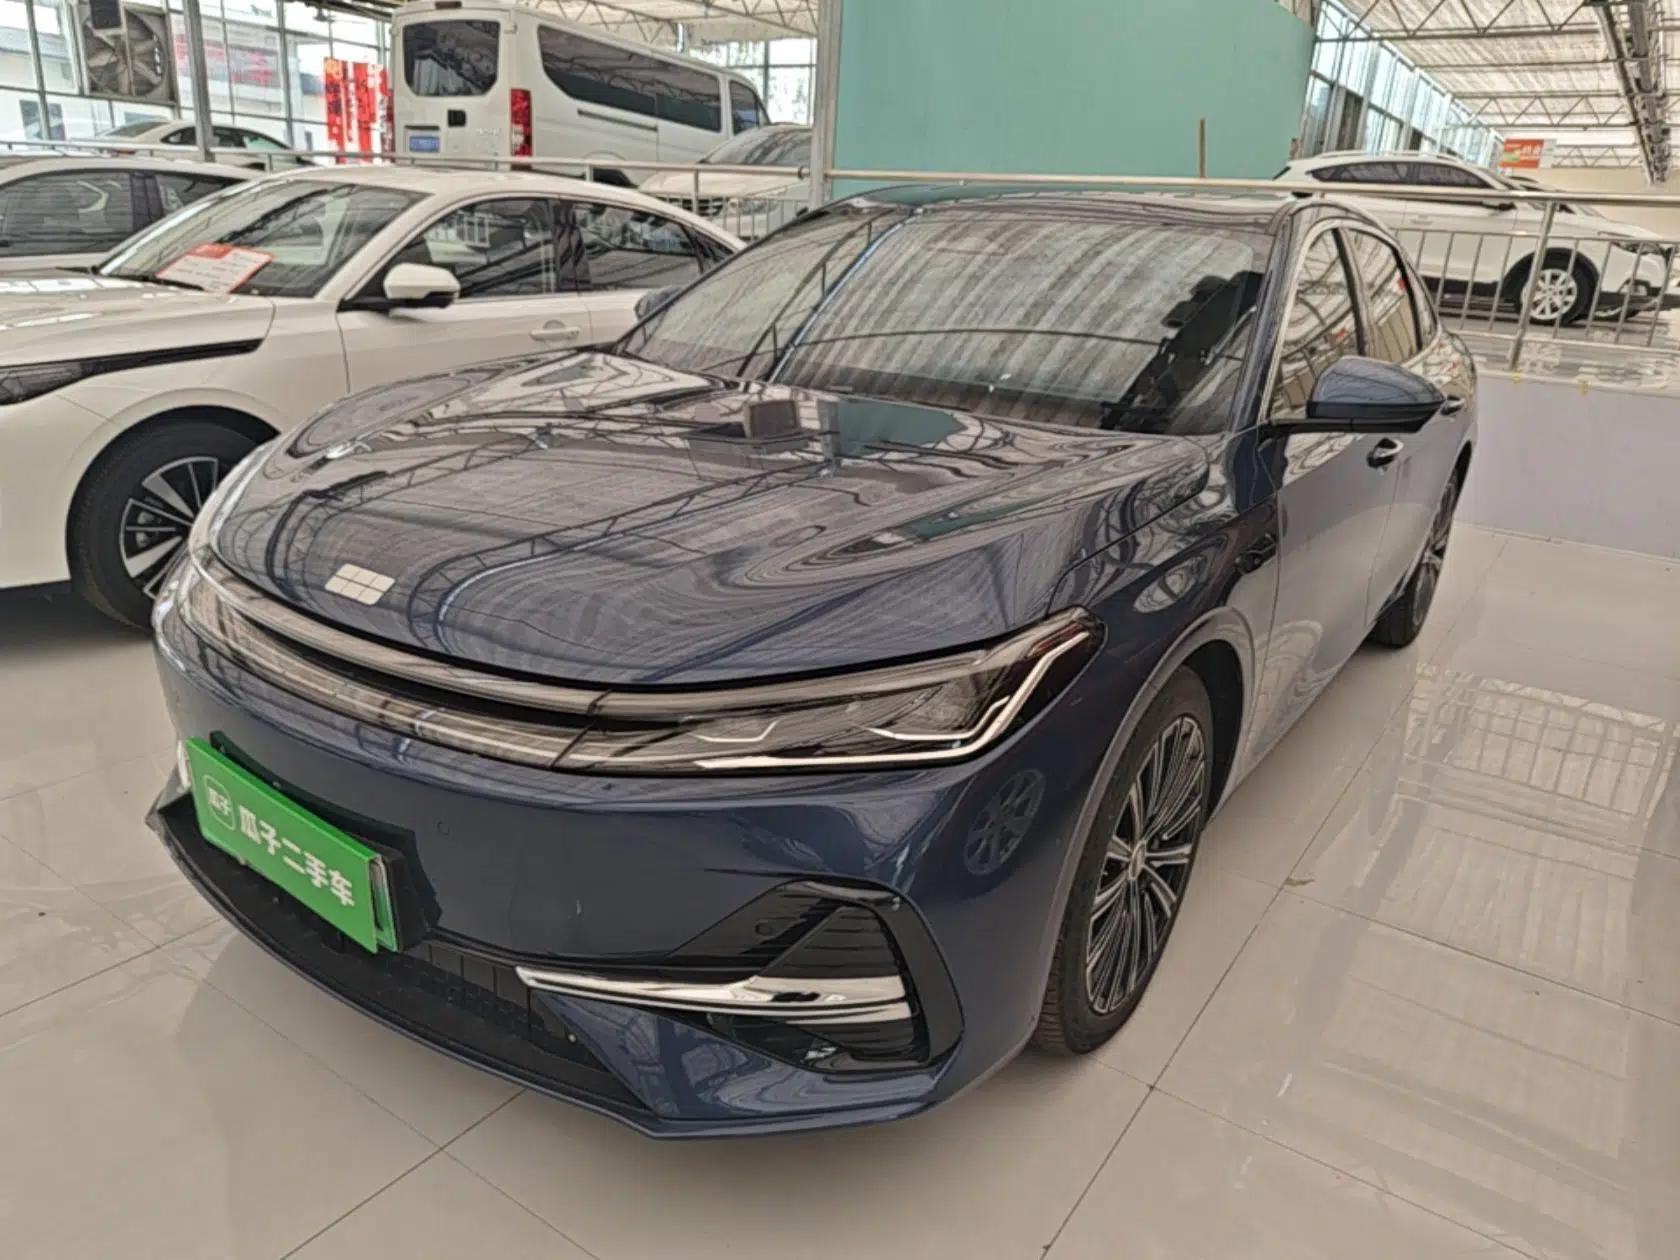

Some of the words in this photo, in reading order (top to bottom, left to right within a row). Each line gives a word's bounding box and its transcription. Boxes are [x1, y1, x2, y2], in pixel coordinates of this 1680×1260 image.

[207, 787, 231, 817] 瓜子
[238, 804, 355, 907] 瓜子二手车
